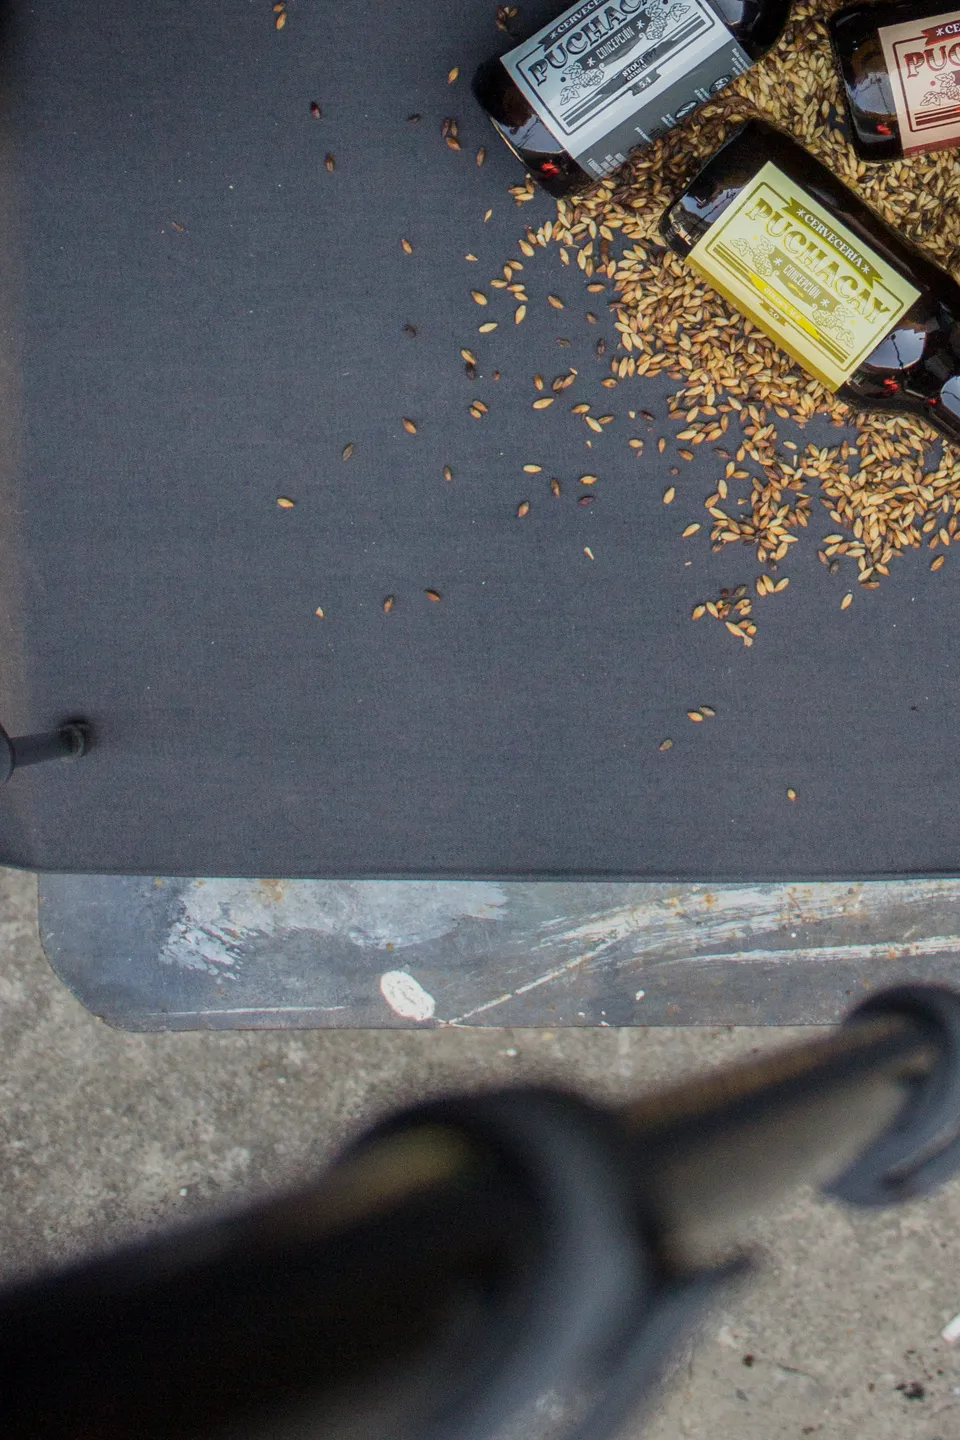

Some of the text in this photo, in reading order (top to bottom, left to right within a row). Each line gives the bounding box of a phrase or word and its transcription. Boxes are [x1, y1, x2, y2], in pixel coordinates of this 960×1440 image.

[595, 25, 635, 61] CONCEPCIÓN
[621, 58, 645, 77] STOUT
[803, 213, 864, 269] CERVECERÍA
[745, 196, 891, 325] PUCHACAY
[782, 263, 823, 299] CONCEPCIÓN
